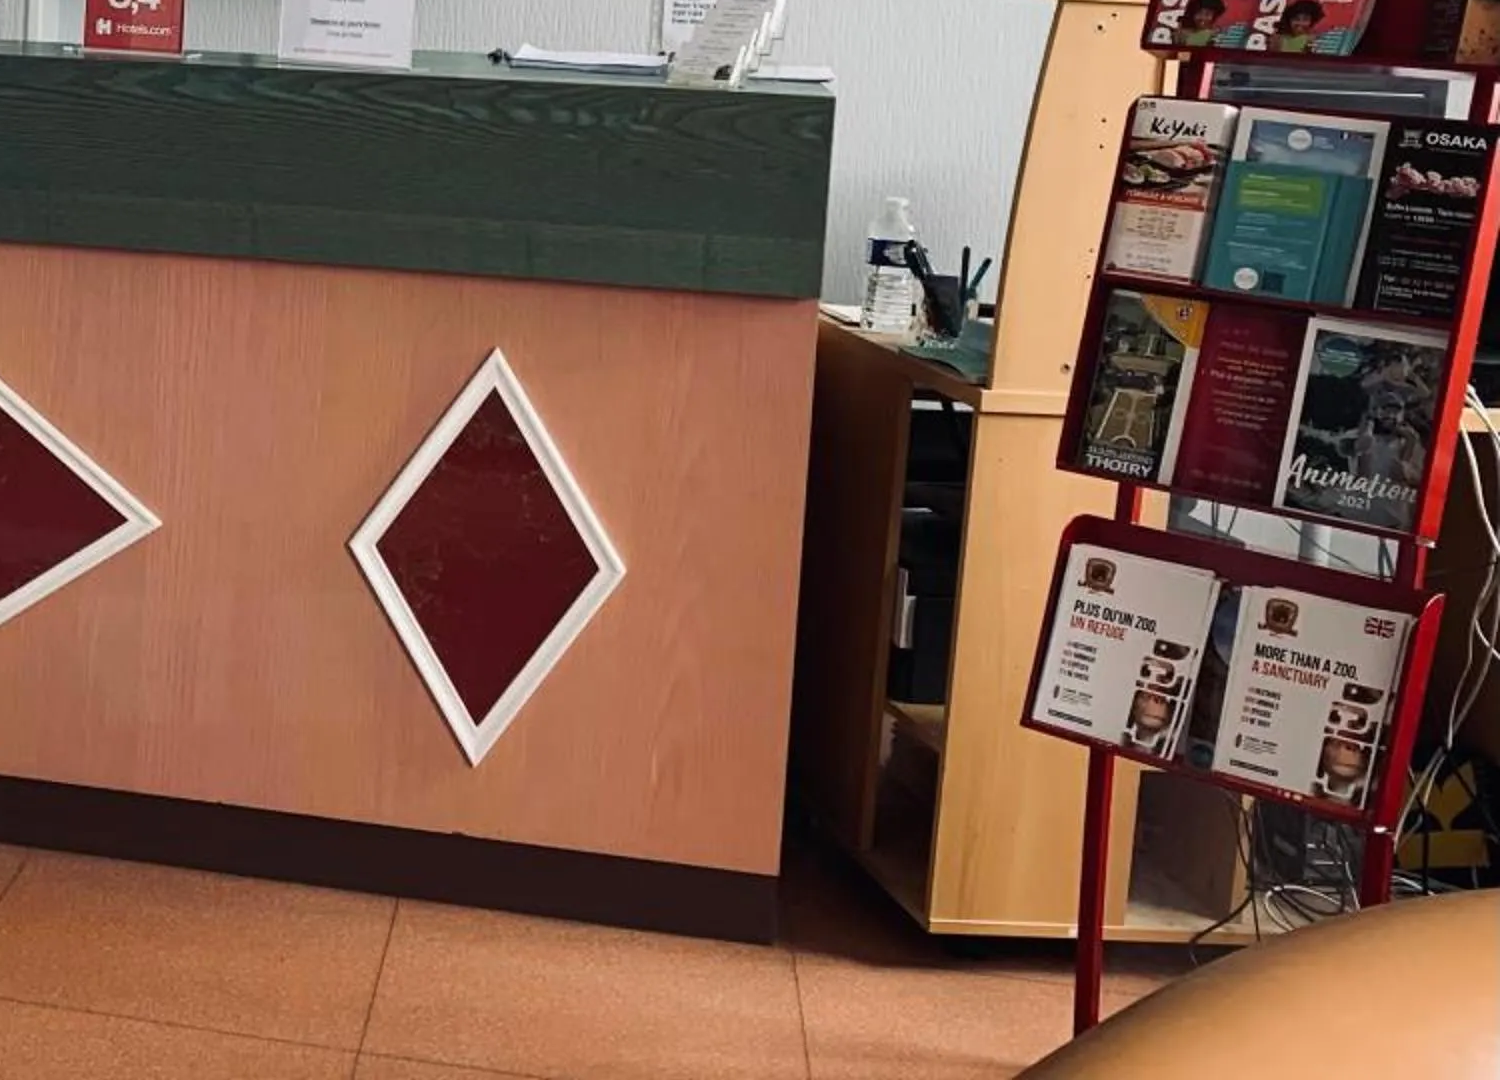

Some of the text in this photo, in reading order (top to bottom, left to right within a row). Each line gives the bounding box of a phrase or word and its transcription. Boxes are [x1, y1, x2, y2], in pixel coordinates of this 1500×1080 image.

[116, 23, 172, 35] Hotels.com
[1425, 132, 1488, 151] OSAKA
[1085, 453, 1152, 478] THOIRY
[1286, 453, 1418, 503] Animation
[1337, 494, 1372, 511] 2021
[1074, 600, 1101, 618] PLUS
[1102, 607, 1134, 626] QU'UN
[1070, 614, 1128, 641] UN REFUGE
[1254, 642, 1288, 662] MORE
[1290, 650, 1321, 670] THAN
[1322, 659, 1331, 672] A
[1251, 659, 1330, 689] A SANCTUARY
